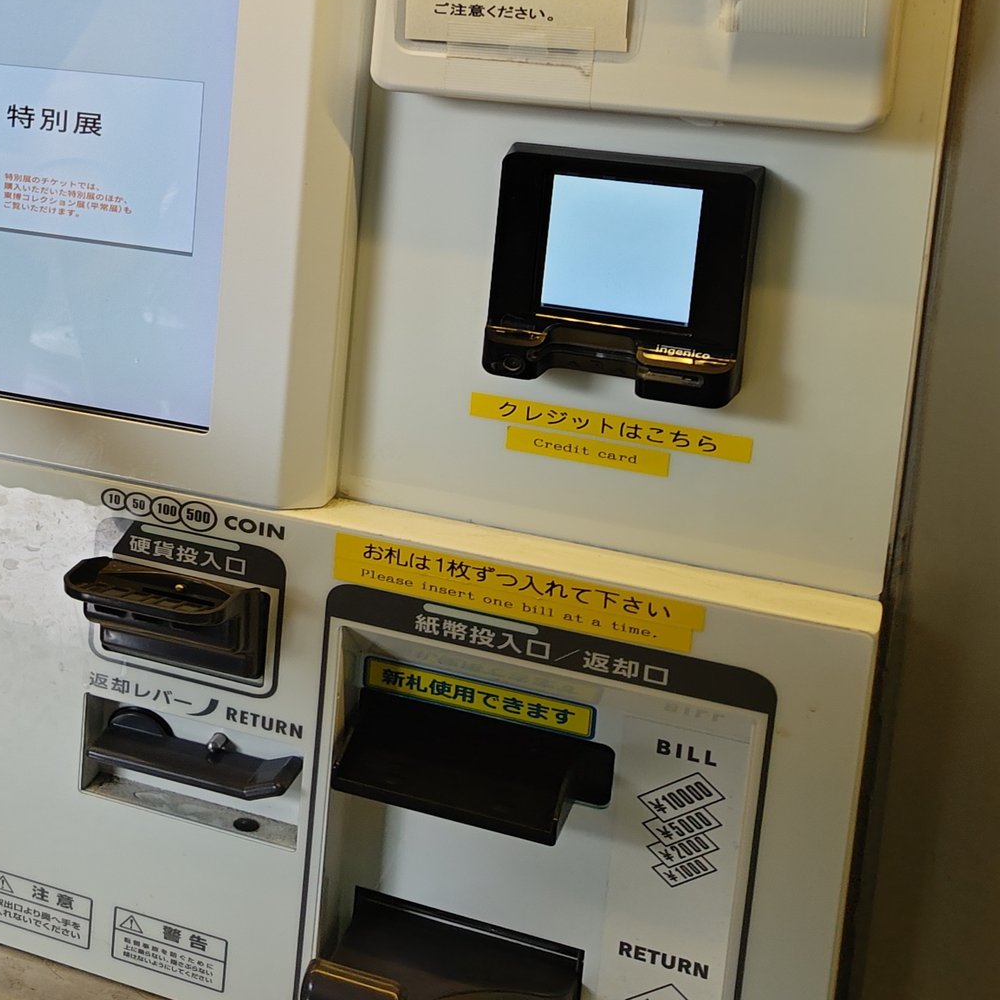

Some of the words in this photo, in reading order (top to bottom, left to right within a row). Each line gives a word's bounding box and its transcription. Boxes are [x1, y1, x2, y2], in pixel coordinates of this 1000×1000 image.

[434, 3, 554, 22] ご注意ください。
[6, 104, 102, 137] 特別展
[5, 173, 100, 191] 特別展のチケットでは、
[3, 202, 80, 218] ご覧いただけます。
[655, 344, 711, 360] ingenico
[499, 401, 718, 453] クレジットはこちら
[534, 438, 589, 456] Credit
[598, 450, 637, 464] card
[109, 493, 121, 505] 10
[132, 498, 145, 511] 50
[157, 502, 177, 517] 100
[186, 508, 210, 525] 500
[224, 516, 285, 540] COIN
[129, 535, 246, 576] 硬貨投入口
[363, 543, 671, 619] お札は1枚ずつ入れて下さい
[361, 567, 413, 589] Please
[421, 580, 475, 601] insert
[484, 594, 514, 609] one
[523, 602, 554, 618] bill
[563, 612, 583, 624] at
[592, 618, 602, 627] a
[612, 619, 657, 639] time.
[89, 671, 193, 706] 返却レバー
[226, 706, 303, 739] RETURN
[381, 667, 575, 725] 新札使用できます
[656, 738, 718, 767] BILL
[32, 884, 74, 910] 注意
[163, 925, 207, 952] 警告
[618, 940, 710, 980] RETURN
